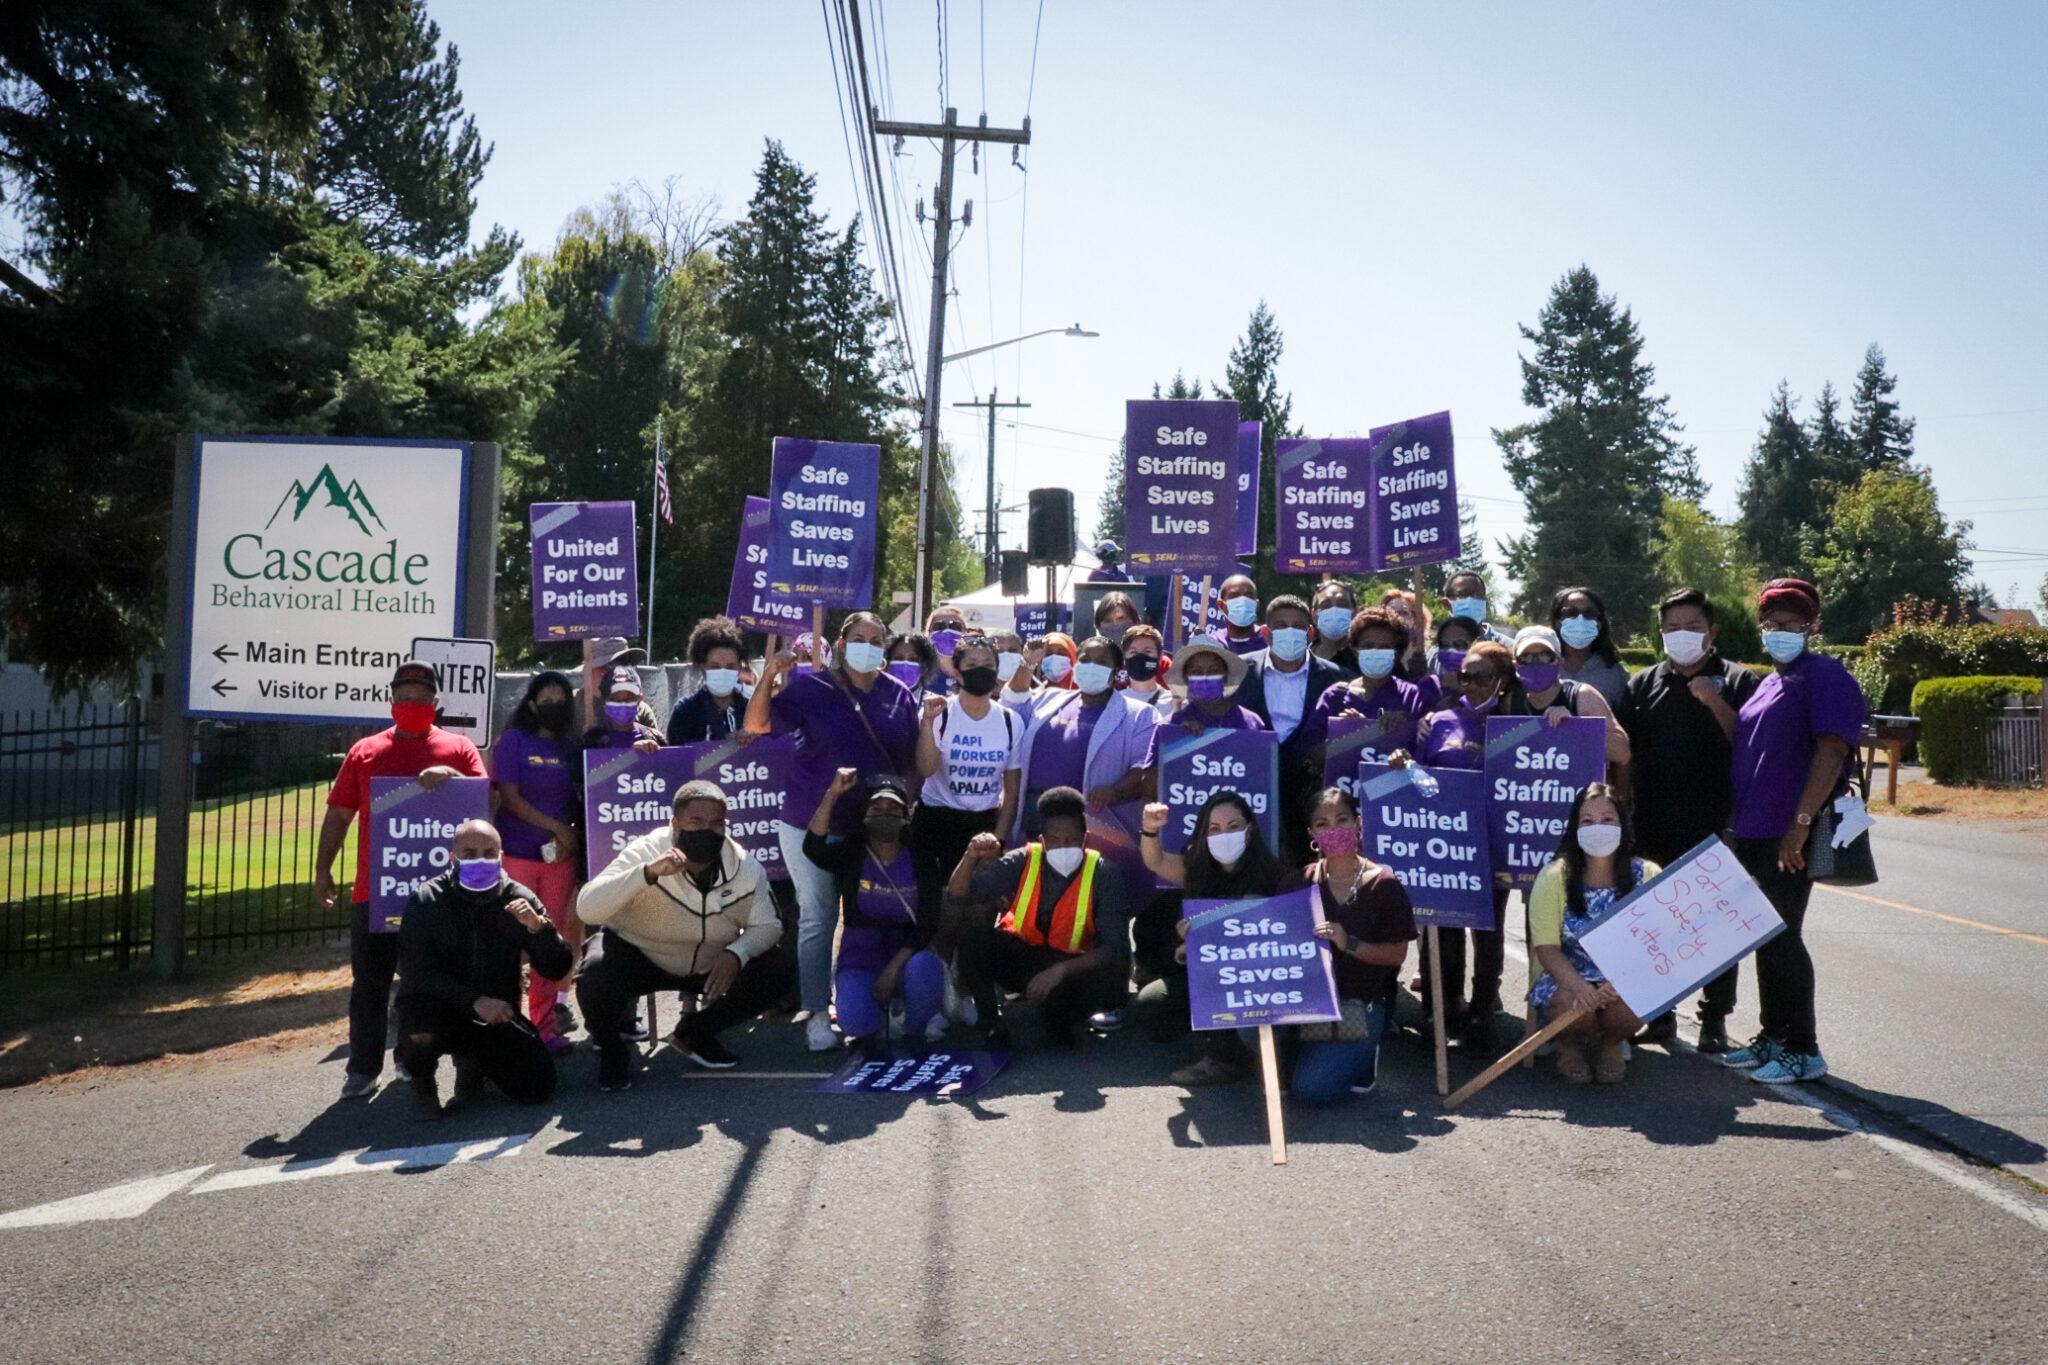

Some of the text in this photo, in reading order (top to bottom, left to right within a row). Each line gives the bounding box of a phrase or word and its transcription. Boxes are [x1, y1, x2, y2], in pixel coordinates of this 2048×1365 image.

[1156, 426, 1208, 446] Safe
[1393, 442, 1430, 467] Safe
[800, 464, 850, 486] Safe
[1137, 455, 1226, 480] Staffing
[1302, 460, 1348, 479] Safe
[1378, 468, 1448, 497] Staffing
[781, 490, 866, 518] Staffing
[1147, 485, 1214, 505] Saves
[1284, 486, 1366, 509] Staffing
[1296, 511, 1354, 530] Saves
[1390, 499, 1441, 522] Saves
[789, 519, 854, 541] Saves
[1151, 515, 1210, 535] Lives
[547, 537, 619, 558] United
[1299, 536, 1351, 555] Lives
[1393, 526, 1439, 548] Lives
[223, 533, 430, 586] Cascade
[792, 547, 849, 569] Lives
[543, 562, 626, 584] For Our
[210, 583, 436, 614] Behavioral Health
[542, 588, 629, 609] Patients
[752, 595, 804, 620] Lives
[1020, 621, 1062, 632] Staffg
[246, 641, 411, 668] Main Entran
[258, 678, 390, 702] Visitor Parki
[434, 663, 486, 694] NTER
[952, 734, 982, 747] AAPI
[950, 750, 1004, 762] WORKER
[1191, 754, 1246, 778] Safe
[1514, 745, 1570, 770] Safe
[719, 761, 769, 784] Safe
[949, 765, 996, 778] POWER
[617, 772, 666, 795] Safe
[1493, 777, 1584, 803] Staffin
[598, 801, 674, 823] Staffin
[1381, 805, 1468, 832] United
[382, 846, 422, 868] For
[1376, 834, 1477, 862] For Our
[1507, 843, 1556, 868] Live
[1690, 852, 1762, 931] Patient
[1223, 918, 1287, 937] Safe
[1653, 879, 1708, 961] Safety
[1199, 941, 1317, 963] Staffing
[1218, 965, 1304, 985] Saves
[1225, 989, 1304, 1008] Lives
[843, 1061, 885, 1086] Lives
[871, 1058, 916, 1088] Saves
[890, 1053, 951, 1092] Staffing
